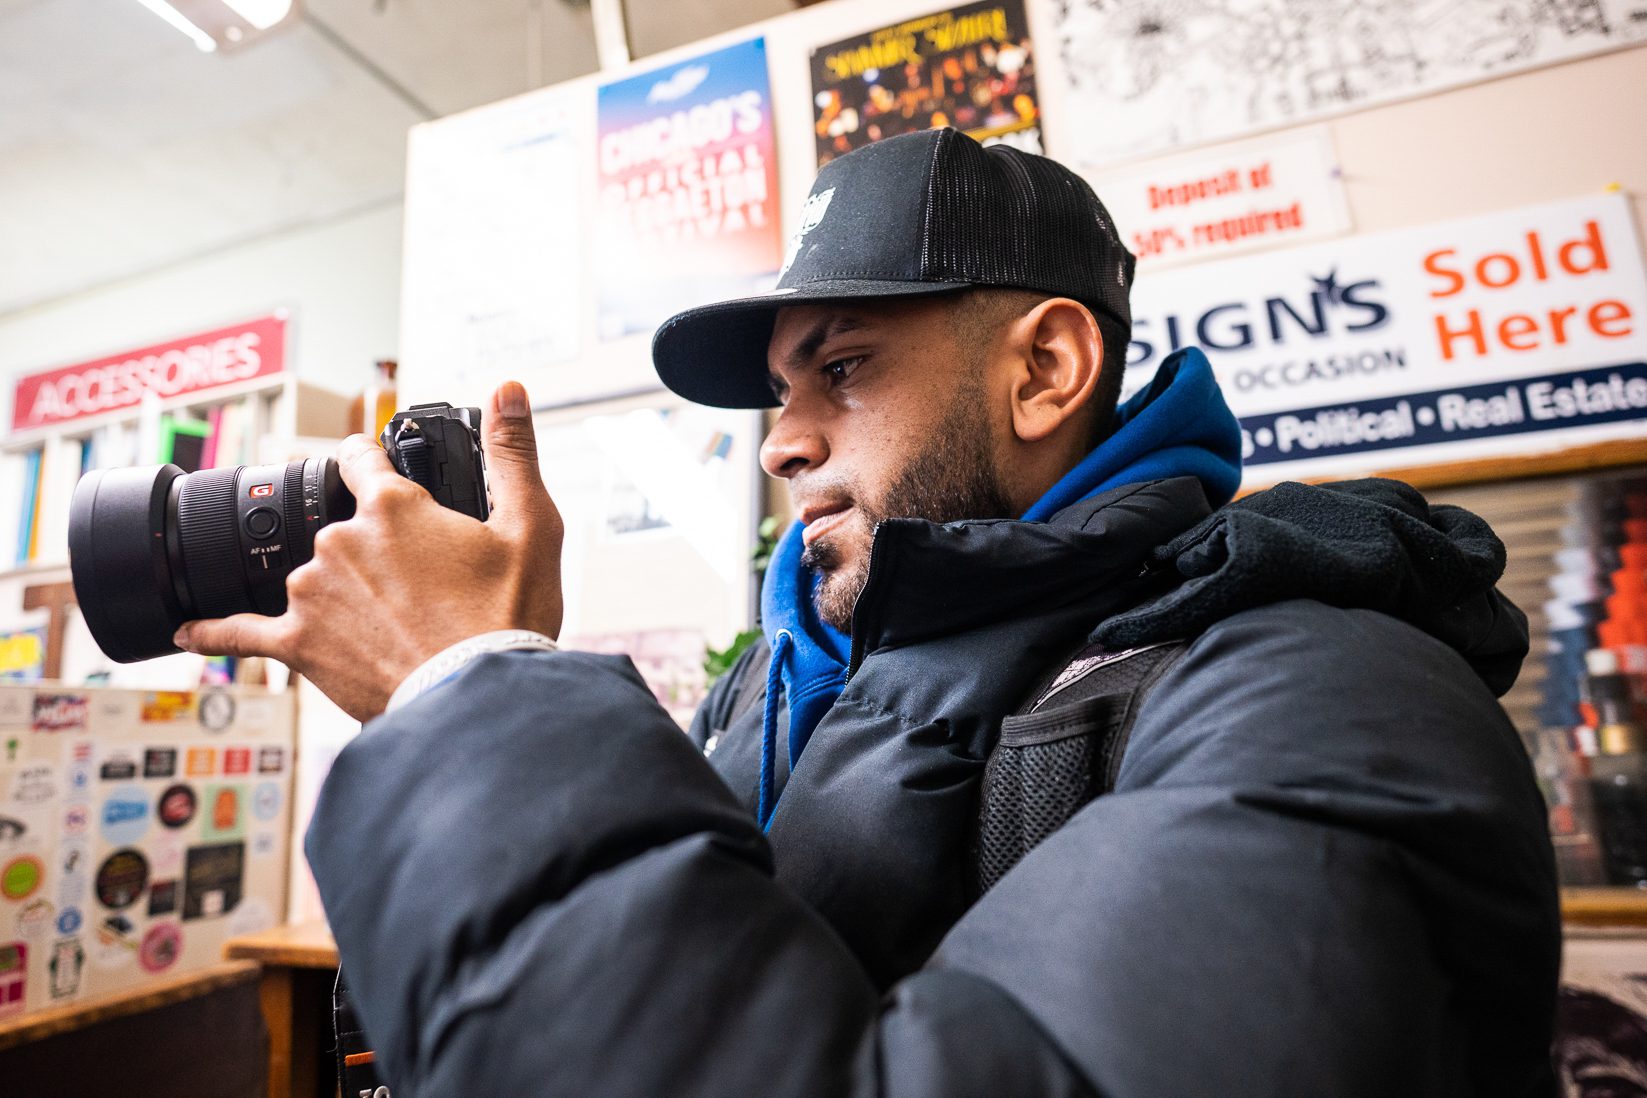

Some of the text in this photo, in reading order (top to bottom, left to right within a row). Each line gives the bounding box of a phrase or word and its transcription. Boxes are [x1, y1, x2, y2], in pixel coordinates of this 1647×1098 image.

[1148, 170, 1240, 210] Deposit
[1193, 202, 1303, 243] required
[1424, 220, 1609, 298] Sold
[1435, 300, 1633, 360] Here
[29, 332, 261, 423] ACCESSORIES
[1234, 350, 1407, 392] OCCASION
[1275, 400, 1416, 452] Political
[1437, 385, 1525, 432] Real
[1525, 372, 1647, 421] Estate
[253, 485, 270, 496] G
[251, 544, 283, 555] AF MF
